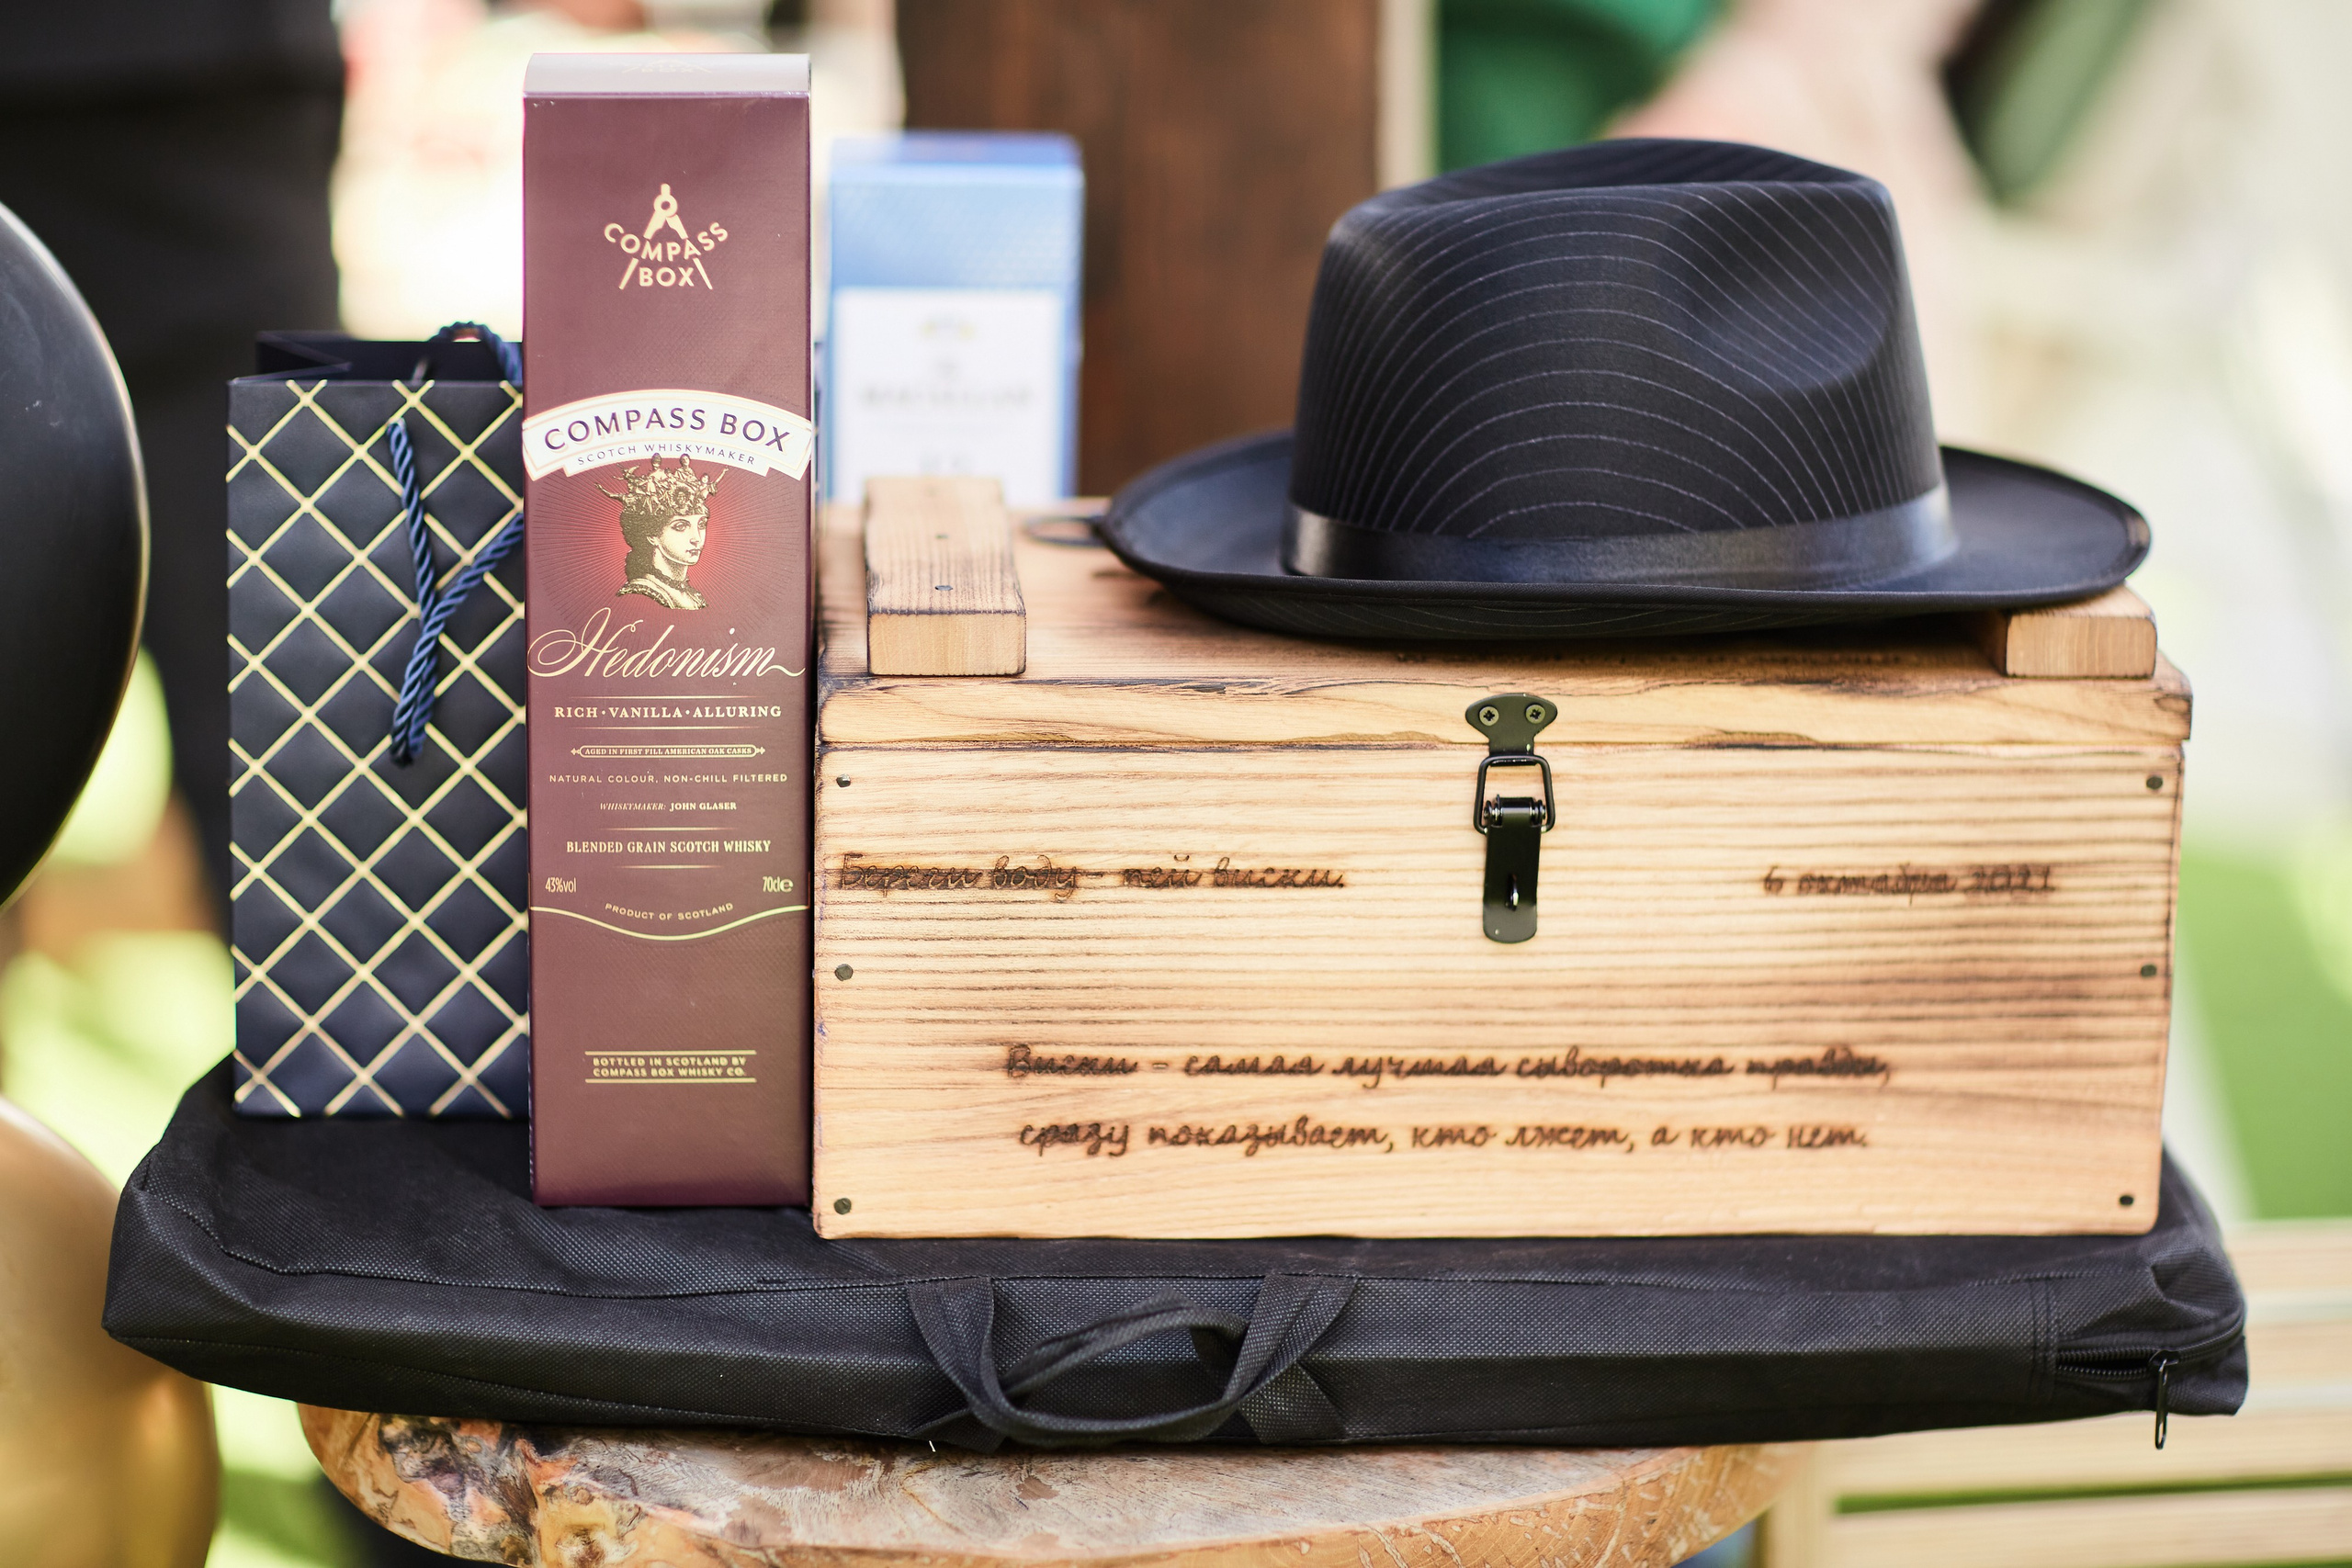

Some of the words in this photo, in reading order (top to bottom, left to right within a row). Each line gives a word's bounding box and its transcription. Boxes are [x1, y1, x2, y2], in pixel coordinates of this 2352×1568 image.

[605, 222, 729, 262] COMPASS
[639, 266, 695, 288] BOX
[544, 407, 707, 450] COMPASS
[719, 412, 790, 452] BOX
[577, 446, 637, 466] SCOTCH
[644, 443, 755, 466] WHISKYMAKER
[527, 607, 806, 679] Hedonism
[620, 747, 643, 755] FIRST
[645, 747, 663, 755] FILL
[664, 747, 707, 755] AMERICAN
[549, 774, 602, 784] NATURAL
[608, 774, 659, 784] COLOUR,
[664, 774, 728, 783] NON-CHILL
[733, 773, 787, 783] FILTERED
[600, 802, 667, 811] WHISKYMAKER:
[670, 802, 696, 812] JOHN
[699, 802, 737, 811] GLASER
[567, 840, 623, 853] BLENDED
[627, 840, 666, 853] GRAIN
[670, 840, 719, 853] SCOTCH
[723, 840, 772, 852] WHISKY
[842, 853, 983, 897] Береги
[993, 854, 1078, 900] воду
[1123, 854, 1203, 888] пей
[1213, 856, 1345, 888] виски.
[1763, 864, 1784, 896] 6
[605, 903, 655, 920] PRODUCT
[658, 912, 673, 921] OF
[677, 902, 734, 920] SCOTLAND
[593, 1057, 646, 1066] BOTTLED
[649, 1057, 662, 1066] IN
[665, 1056, 729, 1066] SCOTLAND
[731, 1056, 747, 1066] BY
[593, 1067, 648, 1077] COMPASS
[650, 1067, 674, 1077] BOX
[678, 1067, 723, 1077] WHISKY
[1007, 1043, 1137, 1078] Виски
[1183, 1055, 1325, 1077] самая
[1331, 1055, 1507, 1089] лучшая
[1516, 1044, 1735, 1089] сыворотка
[1018, 1123, 1129, 1157] сразу
[1148, 1114, 1395, 1157] показывает,
[1410, 1124, 1497, 1149] кто
[1505, 1124, 1635, 1154] лжет,
[1651, 1124, 1679, 1146] а
[1690, 1125, 1775, 1149] кто
[1785, 1123, 1868, 1149] нет.
